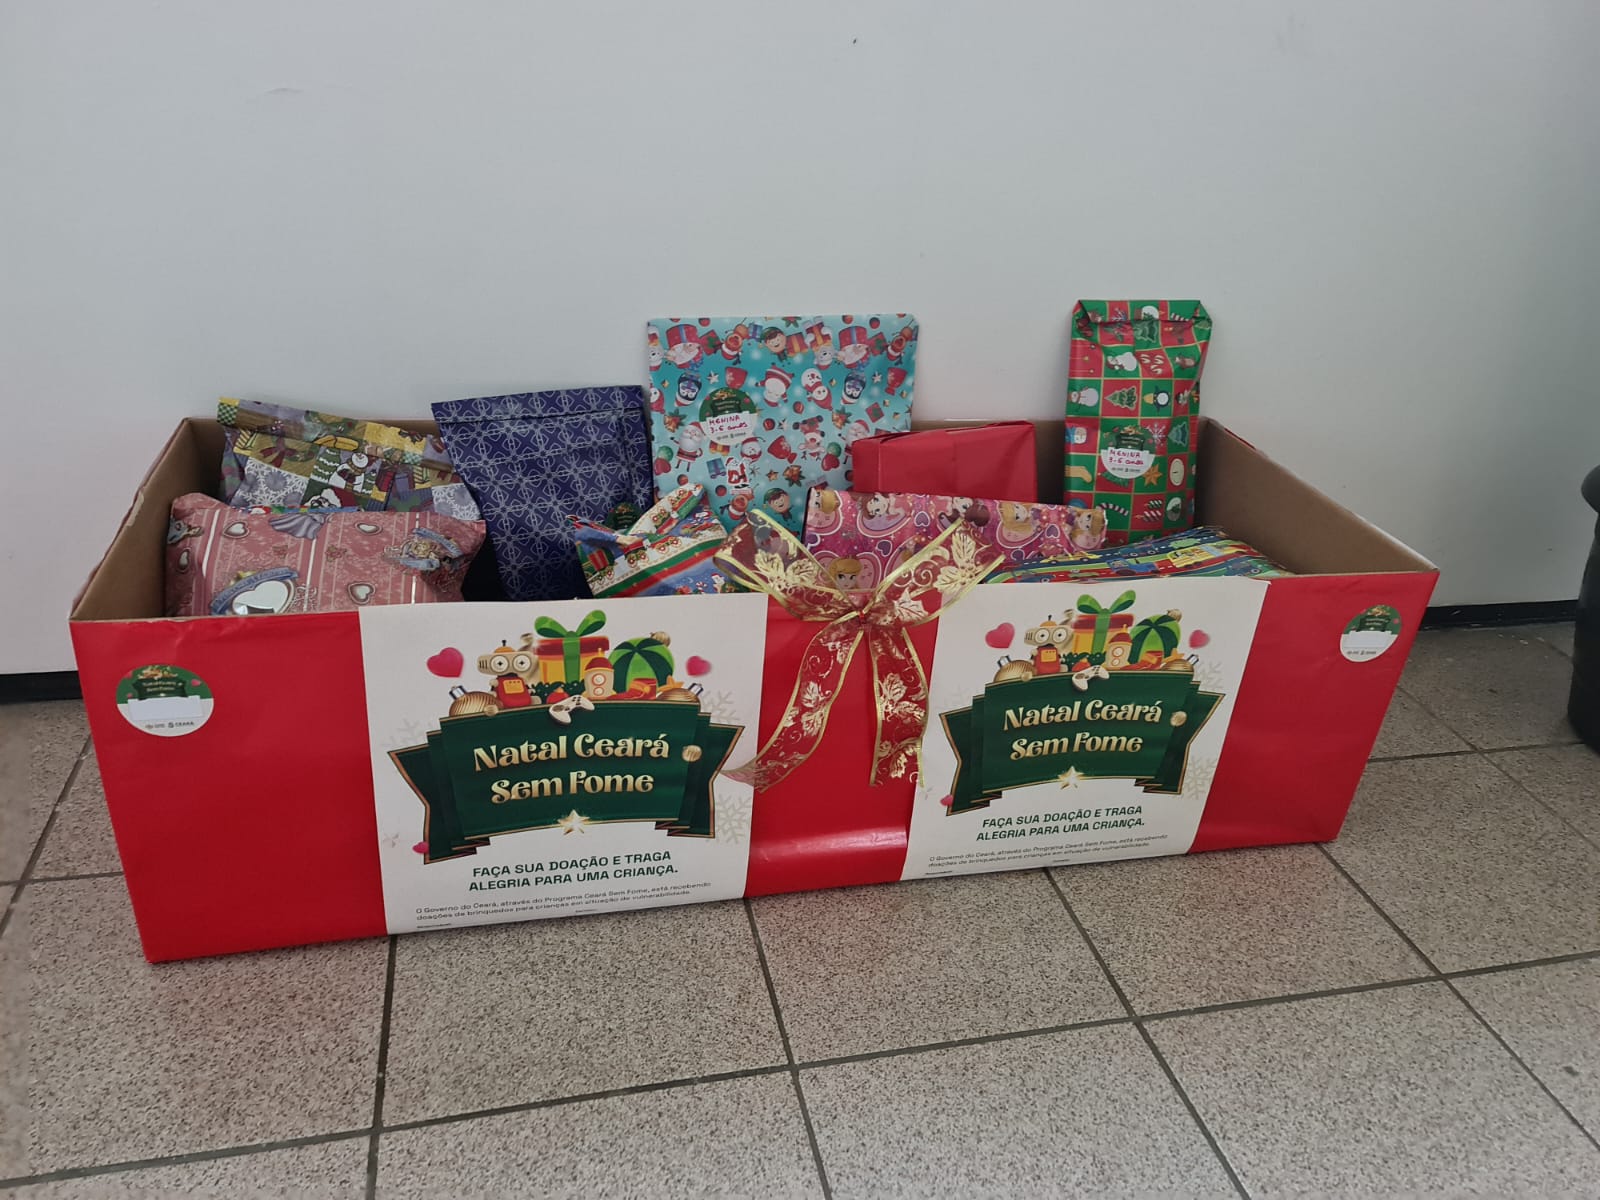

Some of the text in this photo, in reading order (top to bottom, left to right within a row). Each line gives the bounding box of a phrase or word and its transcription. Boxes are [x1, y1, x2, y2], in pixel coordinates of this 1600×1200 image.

[1003, 699, 1162, 731] Natal Ceará
[473, 733, 669, 771] Natal Ceará
[1010, 731, 1143, 760] Sem Fome
[491, 770, 654, 804] Sem Fome
[976, 818, 1145, 841] ALEGRIA PARA UMA CRIANÇA.
[982, 806, 1142, 829] FAÇA SUA DOAÇÃO E TRAGA
[469, 864, 678, 891] ALEGRIA PARA UMA CRIANÇA.
[473, 851, 671, 878] FAÇA SUA DOAÇÃO E TRAGA
[424, 905, 459, 913] Governo
[500, 898, 530, 907] através
[545, 894, 583, 904] Programa
[584, 891, 607, 899] Ceará
[627, 888, 650, 896] Fome,
[651, 885, 668, 893] está
[670, 881, 711, 891] recebendo
[416, 912, 453, 921] doações
[467, 907, 514, 917] brinquedos
